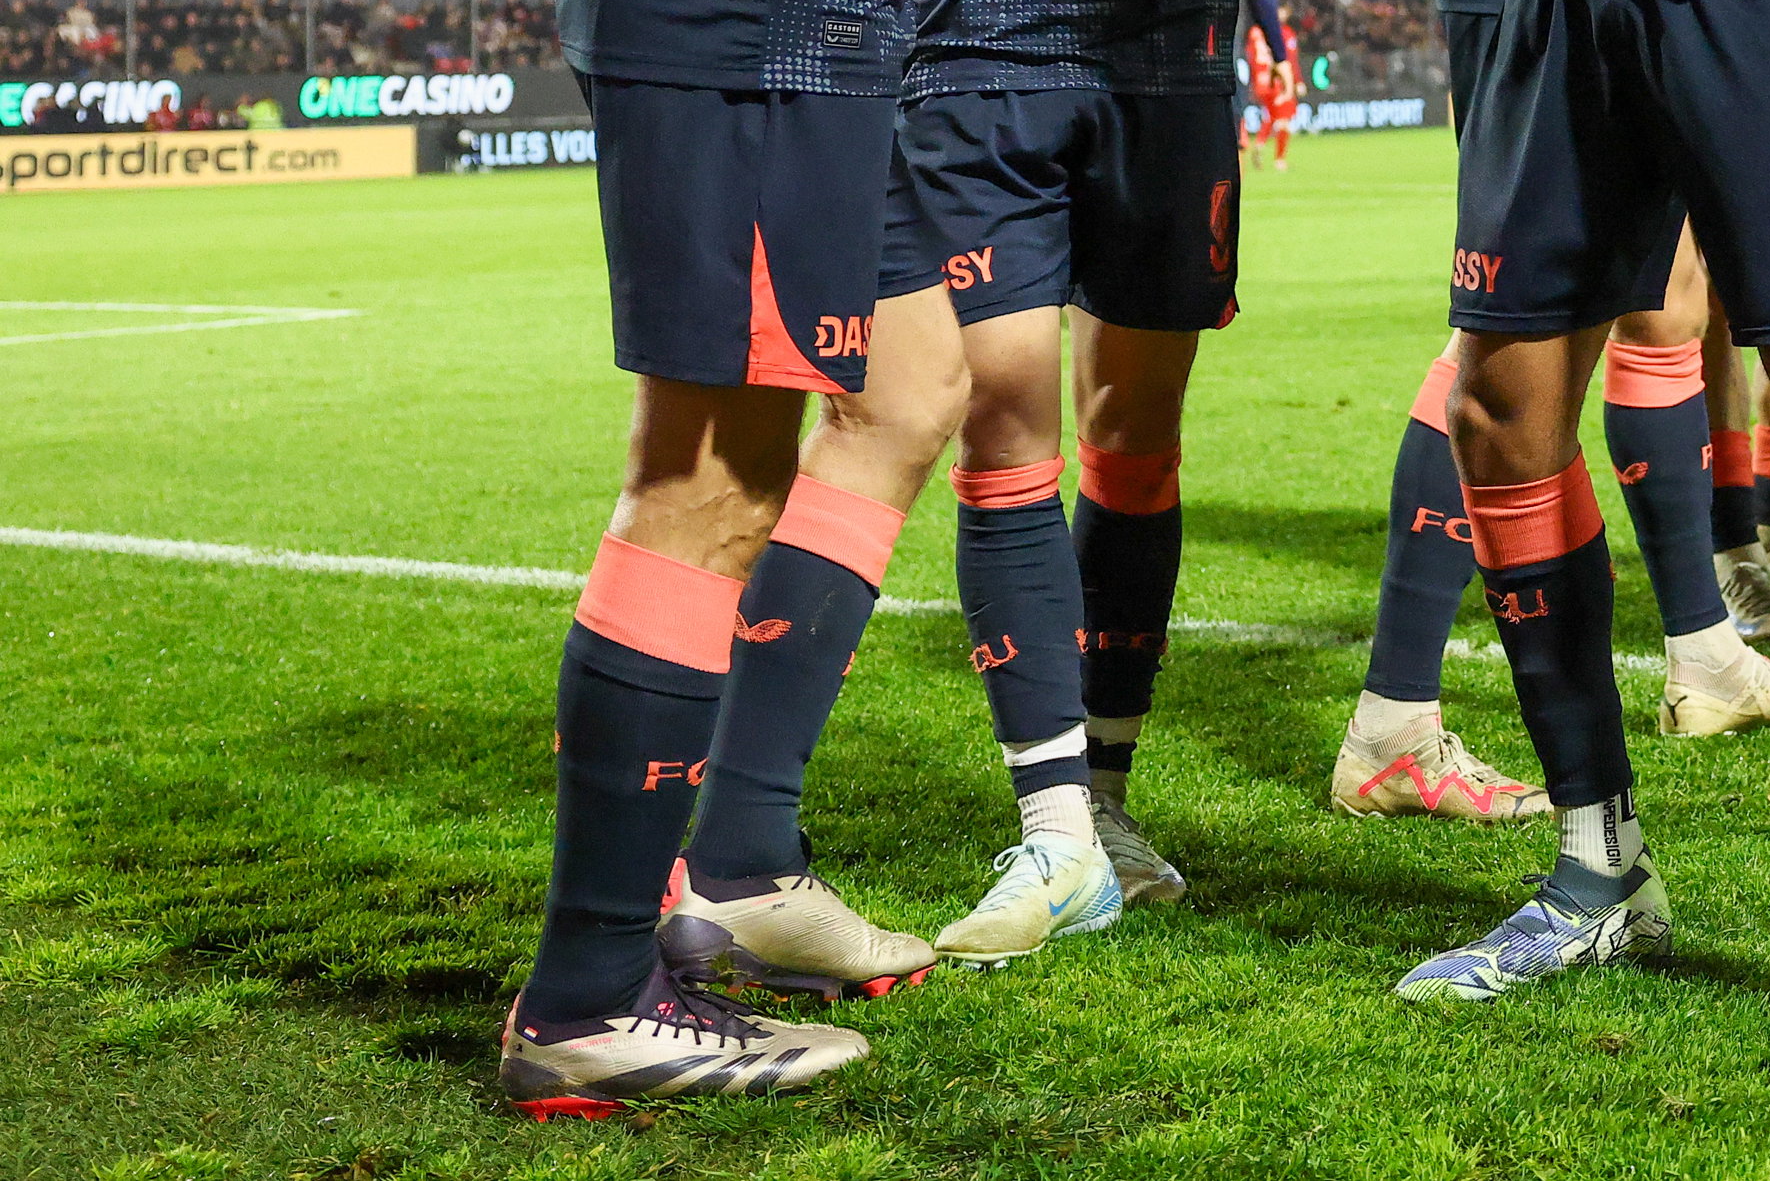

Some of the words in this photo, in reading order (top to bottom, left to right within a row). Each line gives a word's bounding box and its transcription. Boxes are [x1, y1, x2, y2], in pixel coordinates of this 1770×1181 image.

[299, 74, 514, 119] ONECASINO
[941, 246, 993, 290] SY
[1454, 248, 1504, 293] SSY
